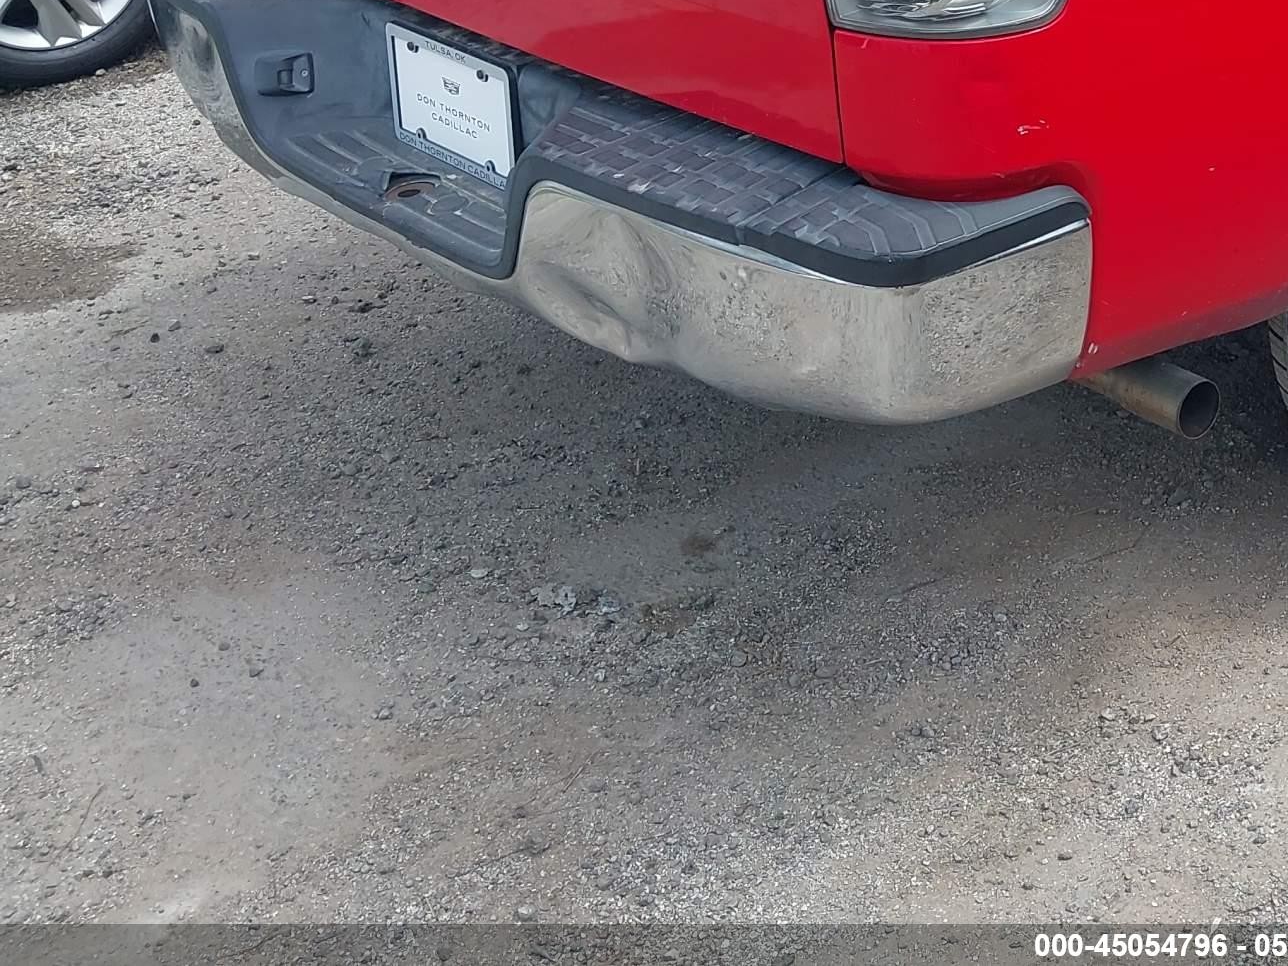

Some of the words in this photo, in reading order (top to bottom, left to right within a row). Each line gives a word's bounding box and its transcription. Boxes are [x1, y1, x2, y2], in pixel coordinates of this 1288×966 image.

[454, 51, 466, 64] OK
[416, 93, 436, 108] DON
[440, 103, 491, 132] THORNTON
[431, 112, 478, 139] CADILLAC
[400, 132, 417, 147] DON
[419, 140, 466, 170] THORNTON
[467, 164, 506, 188] CADILLA
